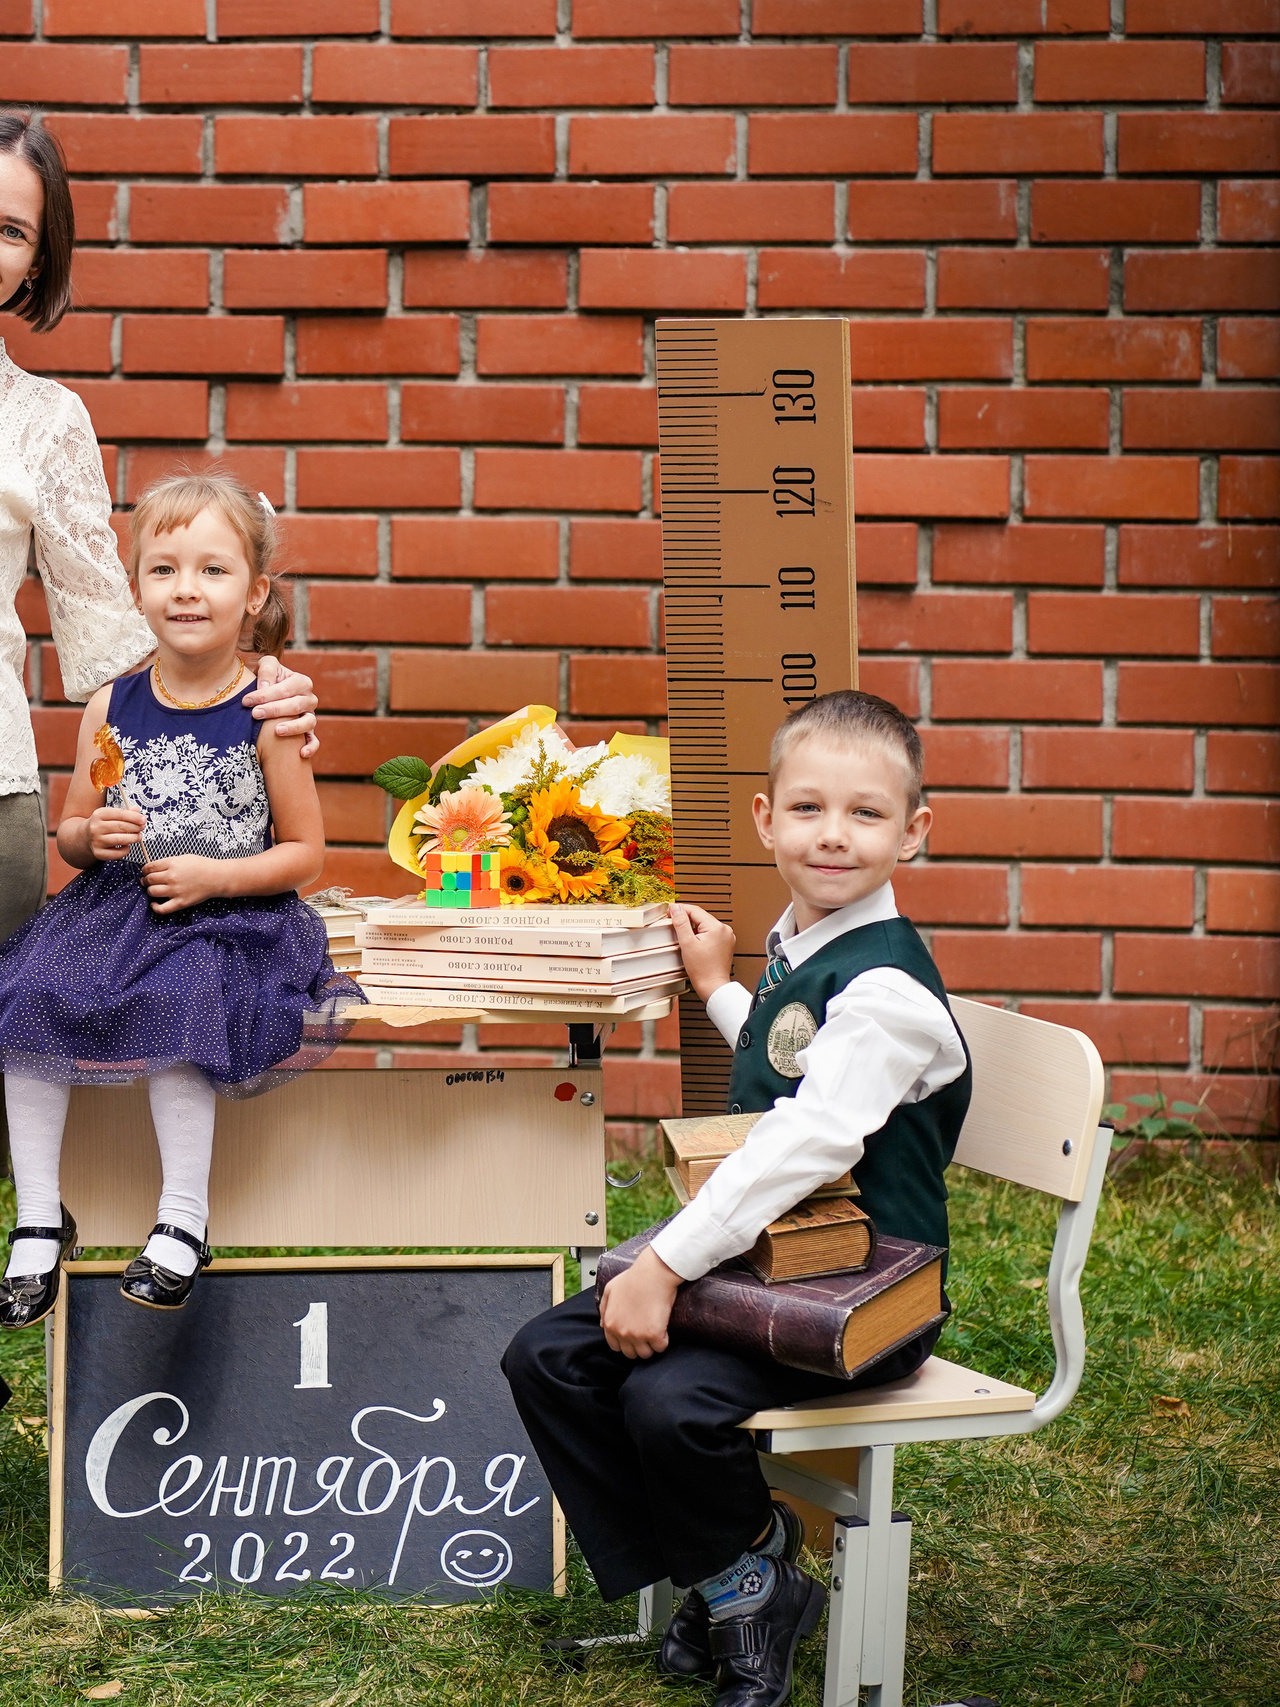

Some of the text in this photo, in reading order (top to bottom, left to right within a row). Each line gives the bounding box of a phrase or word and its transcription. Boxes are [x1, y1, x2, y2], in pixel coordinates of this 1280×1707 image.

[773, 369, 816, 425] 130
[773, 466, 816, 518] 120
[778, 566, 816, 610] 110
[781, 653, 817, 705] 100
[460, 916, 499, 924] СЛОВО
[503, 916, 550, 924] РОДНОЕ
[440, 935, 471, 944] СЛОВО
[475, 937, 513, 945] РОДНОЕ
[448, 961, 480, 970] СЛОВО
[484, 963, 522, 972] РОДНОЕ
[549, 966, 583, 974] Ушинский
[448, 994, 485, 1003] СЛОВО
[489, 995, 533, 1005] РОДНОЕ
[544, 999, 582, 1007] Ушинский
[773, 1056, 797, 1067] АЛЕКС
[293, 1302, 332, 1388] 1
[85, 1391, 540, 1586] Сентября
[179, 1531, 356, 1584] 2022
[720, 1555, 755, 1587] SPORTS
